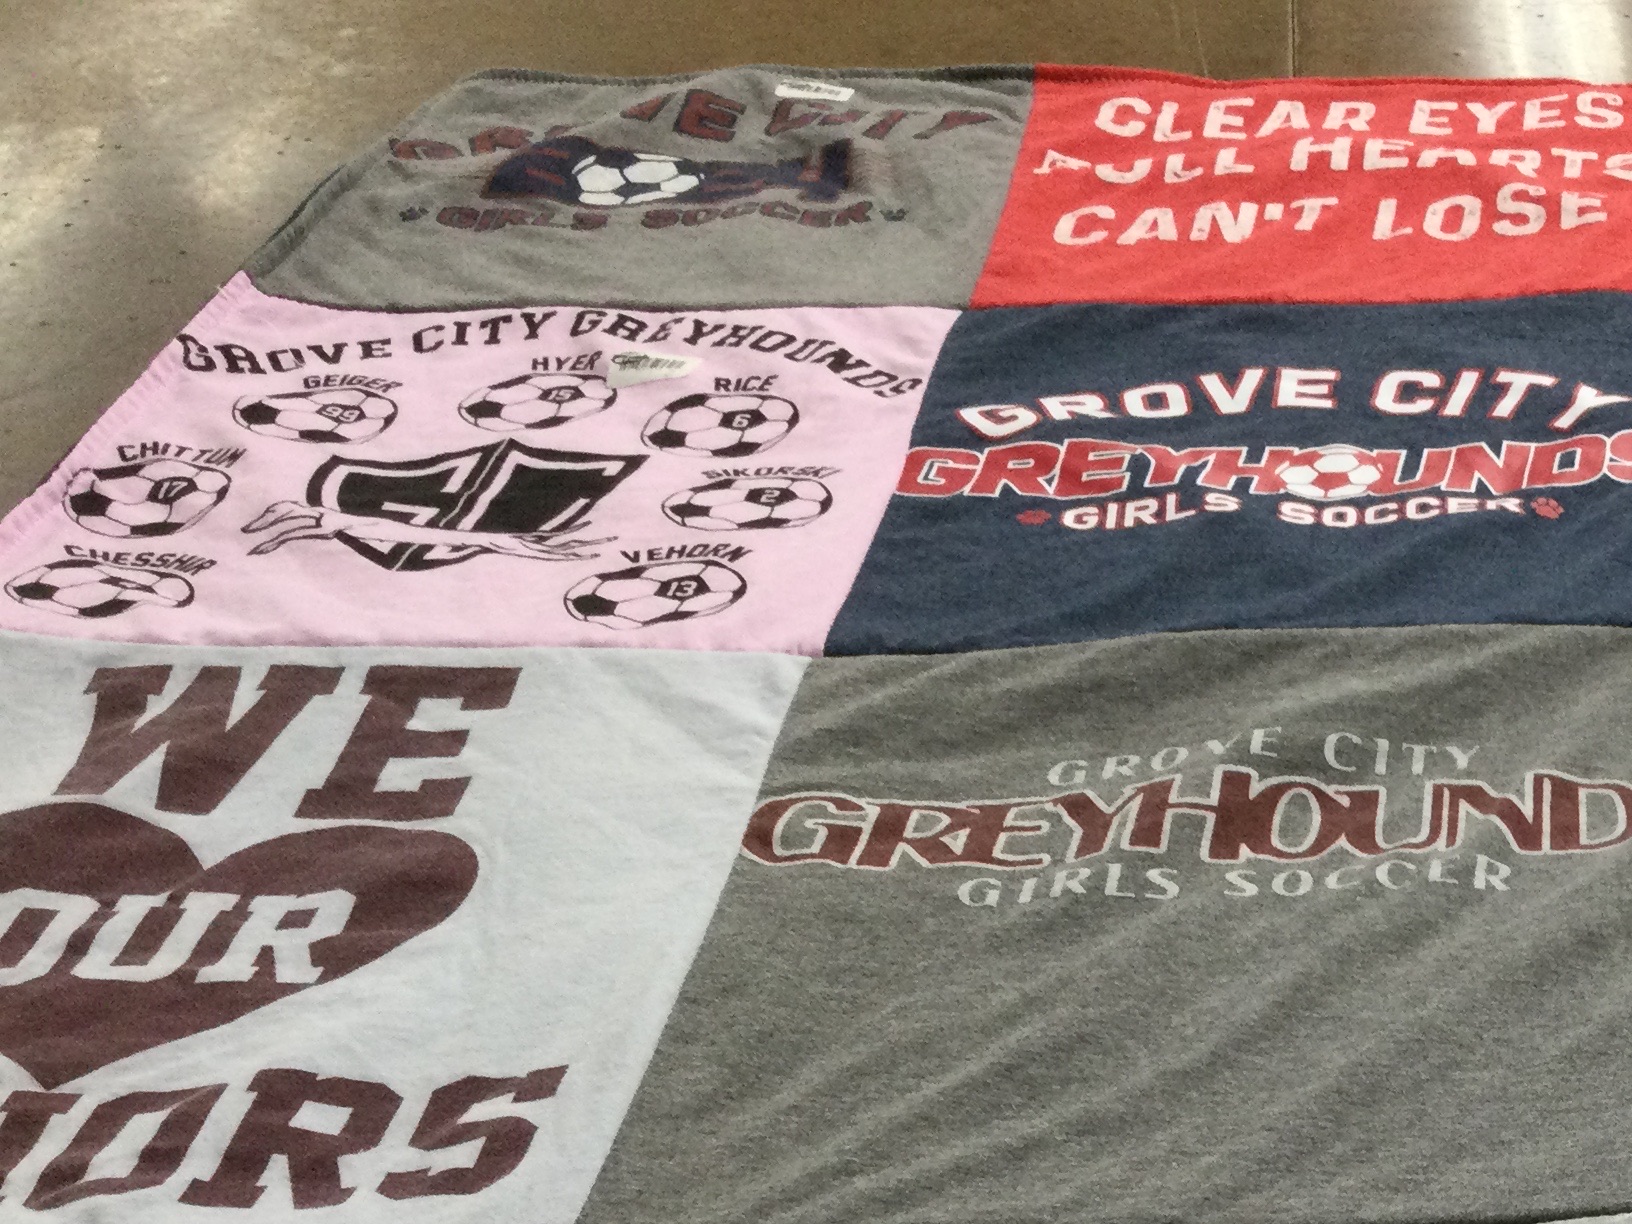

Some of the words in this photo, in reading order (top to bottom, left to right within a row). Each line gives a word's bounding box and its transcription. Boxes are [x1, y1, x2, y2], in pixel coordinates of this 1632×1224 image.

[1094, 97, 1377, 142] CLEAR
[1409, 90, 1625, 136] EYES
[1053, 196, 1338, 245] CAN'T
[1372, 183, 1608, 242] LOSE
[177, 333, 392, 374] GROVE
[412, 311, 557, 354] CITY
[569, 310, 923, 399] GREYHOUNDS
[531, 350, 603, 371] HYER
[303, 374, 403, 391] GEIGER
[714, 375, 779, 392] RICE
[323, 405, 359, 423] 99
[957, 367, 1340, 440] GROVE
[732, 413, 750, 428] 6
[117, 441, 248, 467] CHITTUM
[158, 481, 184, 499] 17
[760, 489, 780, 503] 2
[1060, 492, 1242, 532] GIRLS
[1276, 495, 1525, 529] SOCCER
[620, 543, 753, 563] VEHORN
[666, 580, 698, 598] 13
[51, 664, 523, 822] WE
[1047, 726, 1283, 787] GROVE
[1324, 732, 1480, 776] CITY
[958, 861, 1181, 908] GIRLS
[1223, 853, 1513, 898] SOCCER
[0, 887, 357, 985] OUR
